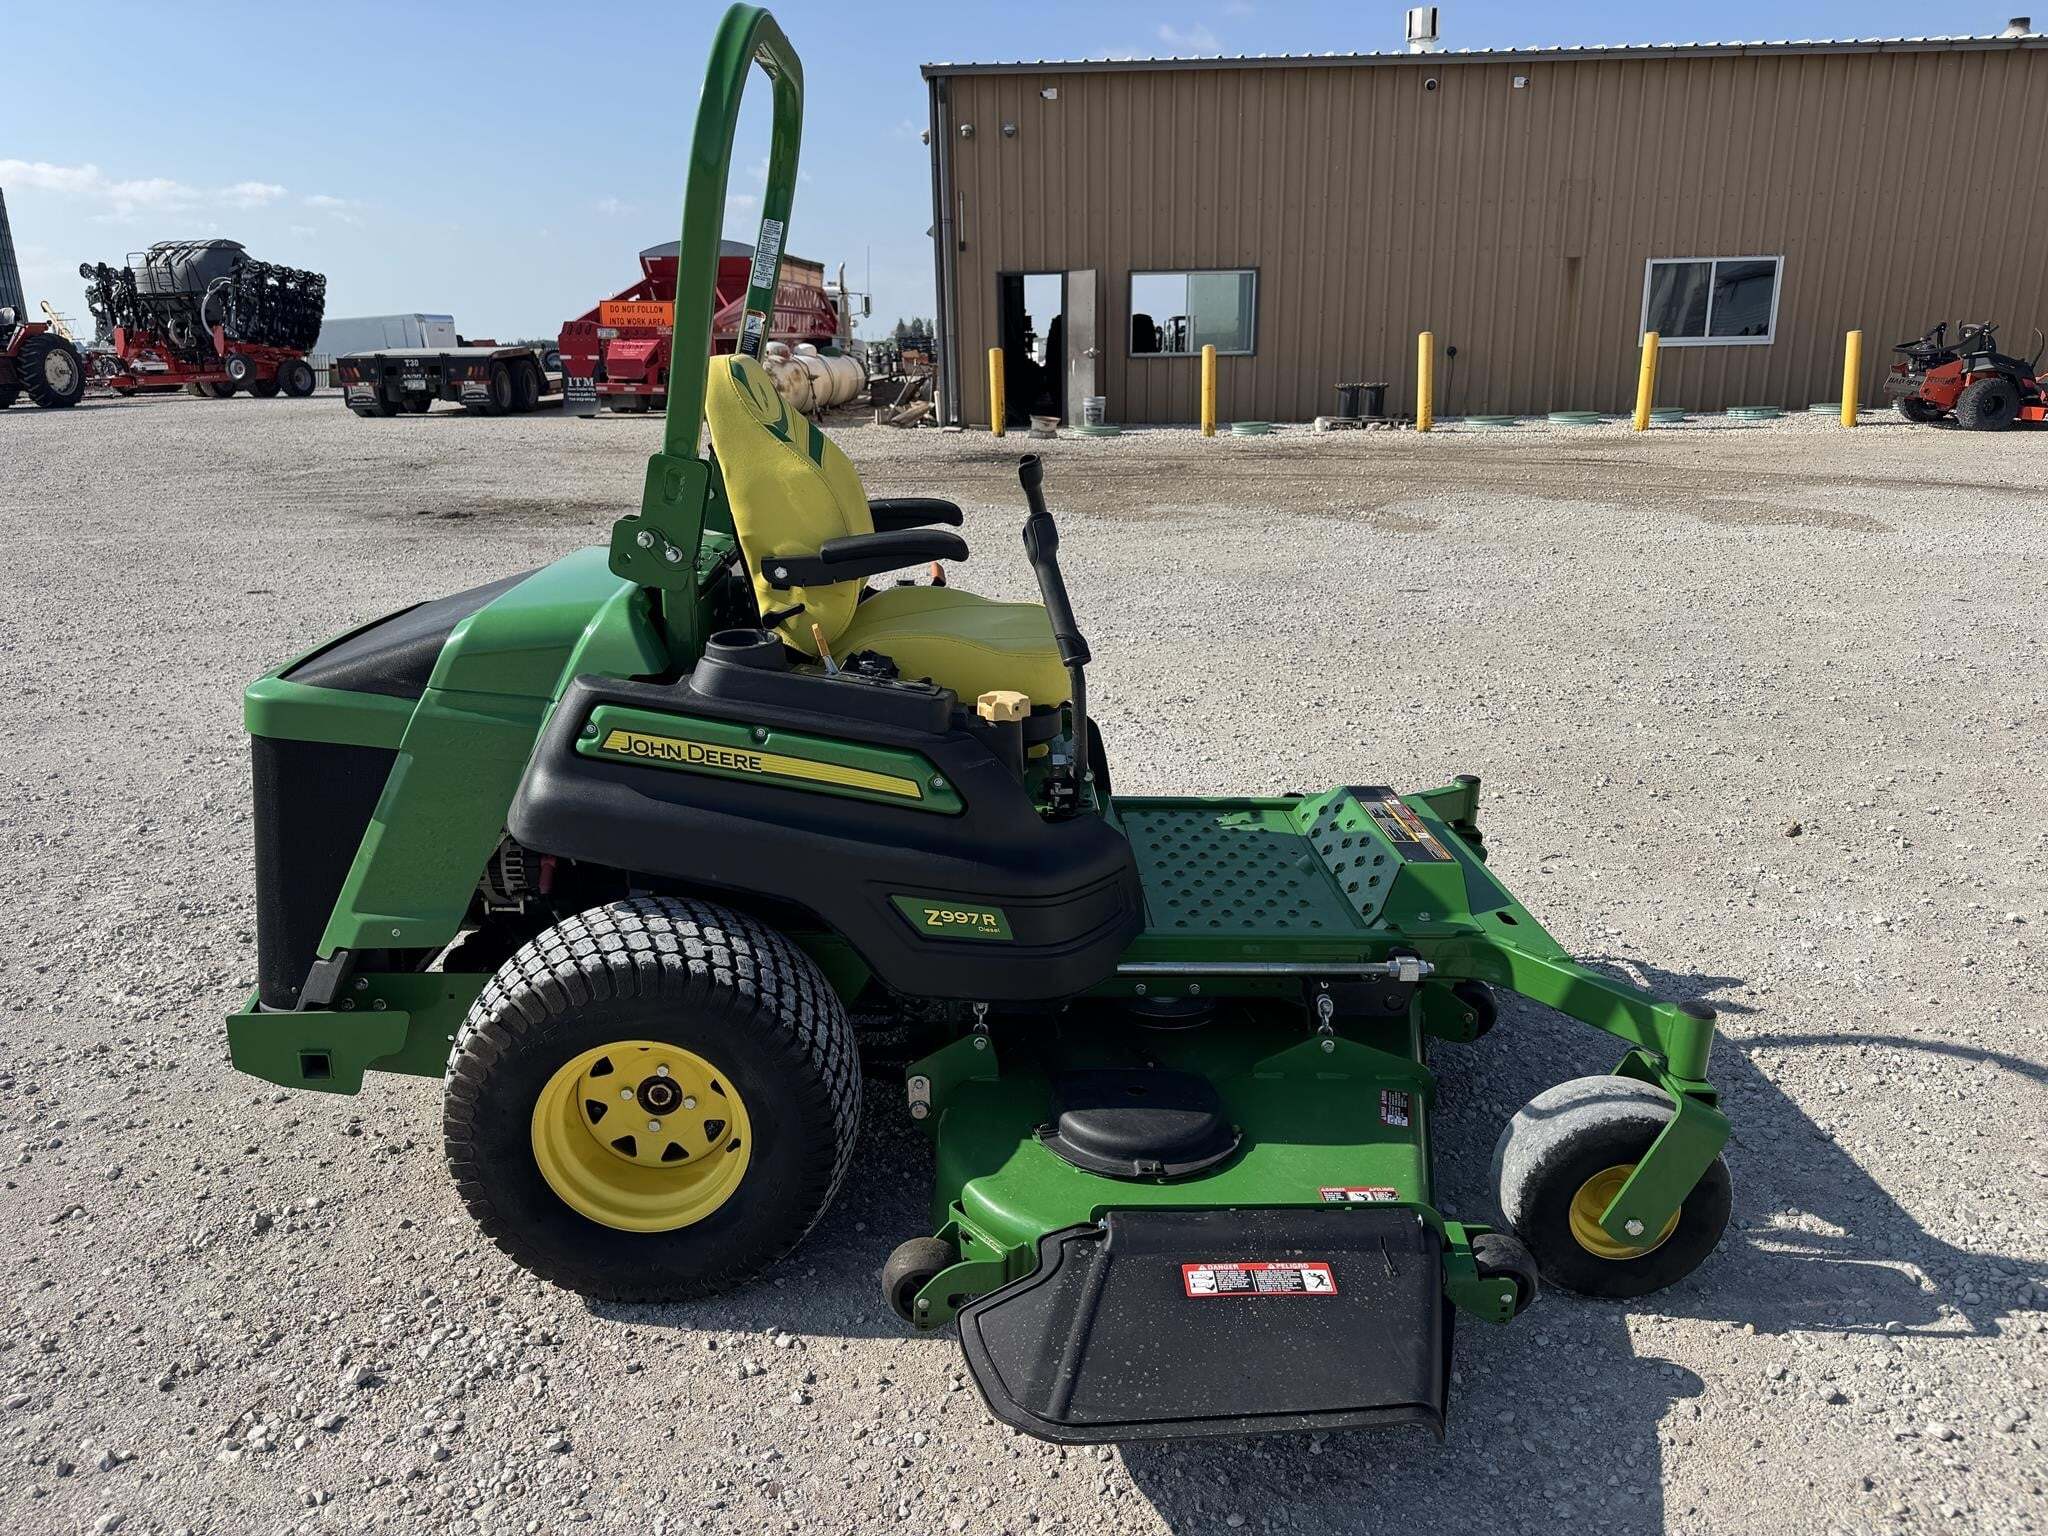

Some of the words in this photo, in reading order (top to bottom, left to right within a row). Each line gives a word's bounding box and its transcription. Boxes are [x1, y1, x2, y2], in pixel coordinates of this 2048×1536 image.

[609, 305, 620, 314] DO
[621, 305, 636, 314] NOT
[637, 305, 664, 314] FOLLOW
[609, 317, 625, 326] INTO
[626, 317, 646, 326] WORK
[648, 318, 666, 327] AREA
[567, 377, 594, 387] ITM
[619, 734, 683, 759] JOHN
[685, 743, 762, 771] DEERE
